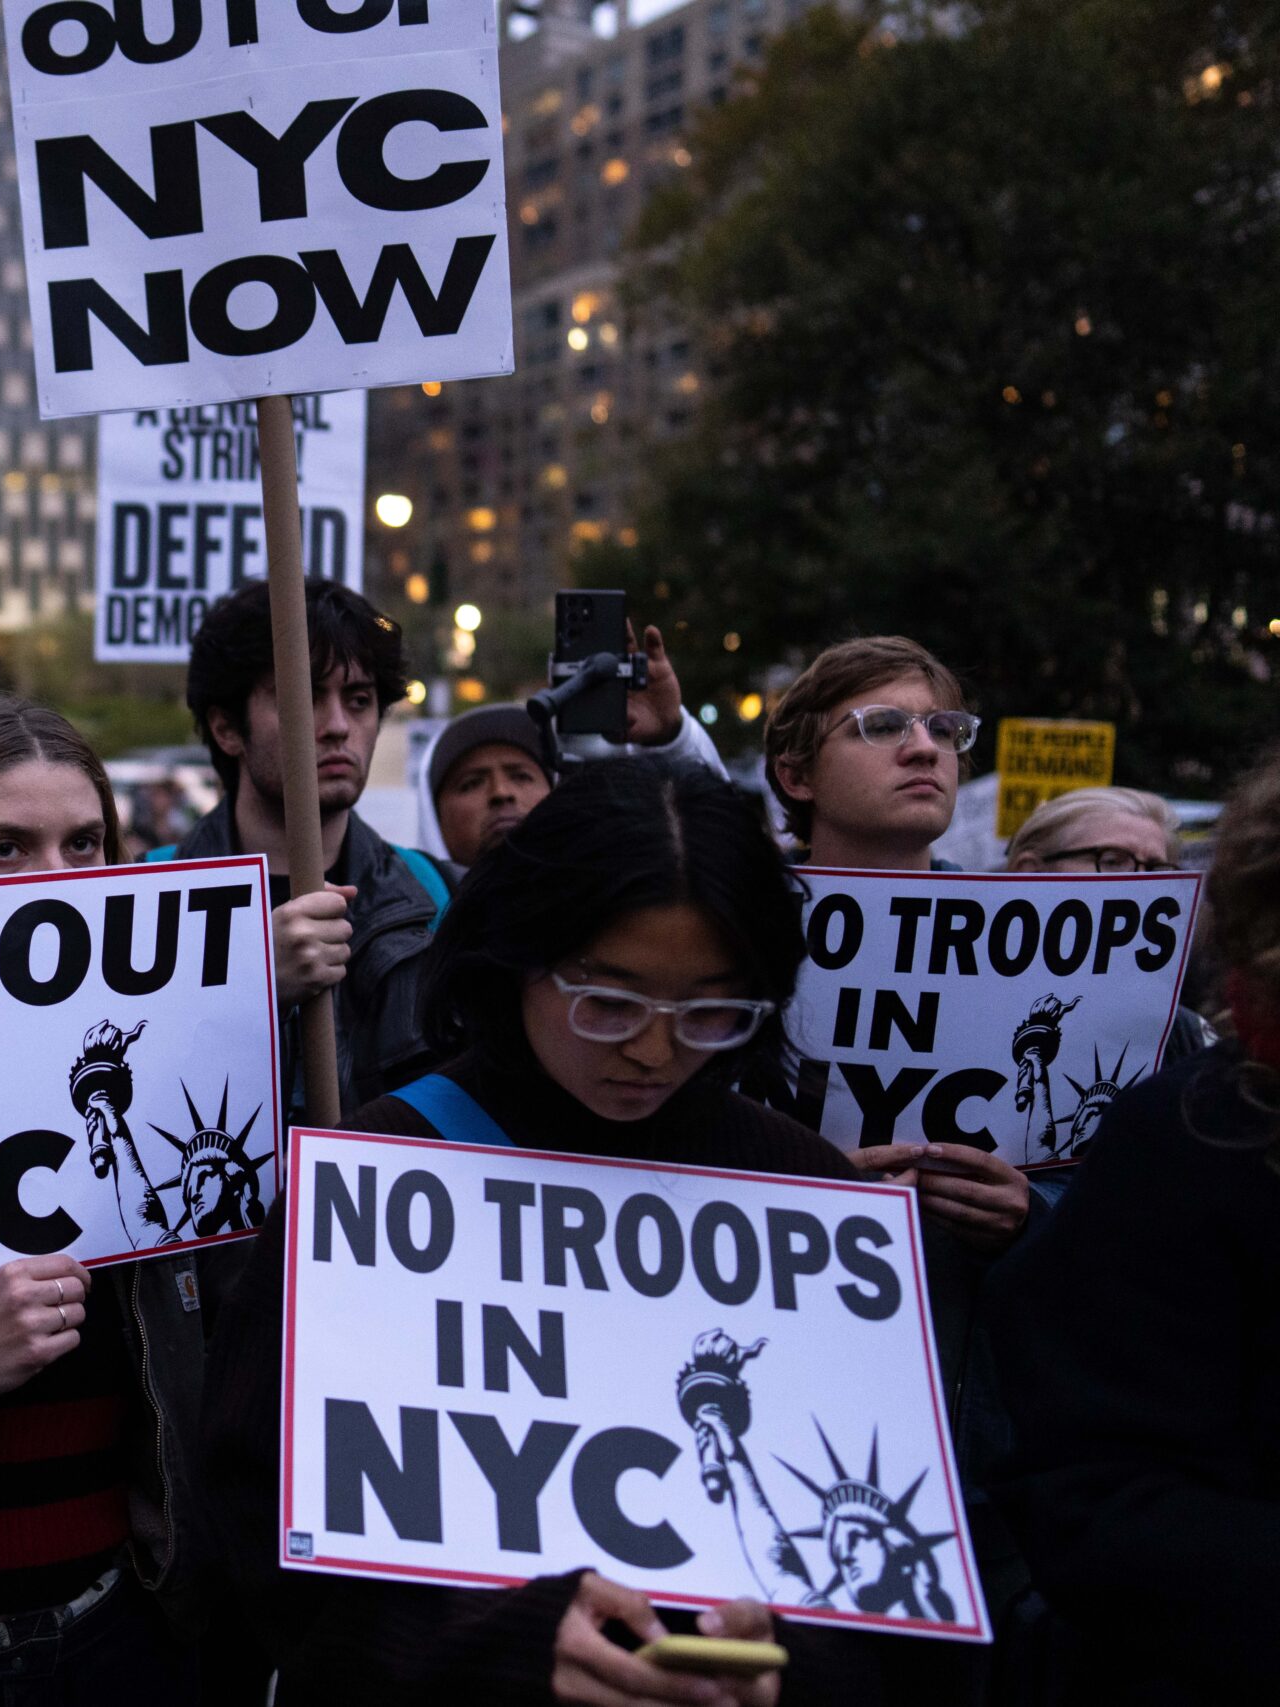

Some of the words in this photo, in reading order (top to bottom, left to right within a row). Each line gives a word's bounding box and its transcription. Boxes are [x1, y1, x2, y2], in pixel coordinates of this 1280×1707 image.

[35, 89, 490, 250] NYC
[47, 234, 497, 373] NOW
[113, 502, 347, 590] DEFED
[789, 892, 863, 970] O
[889, 896, 1180, 977] TROOPS
[833, 987, 940, 1053] IN
[312, 1161, 455, 1274] NO
[484, 1178, 903, 1321] TROOPS
[436, 1299, 568, 1399] IN
[324, 1397, 695, 1569] NYC
